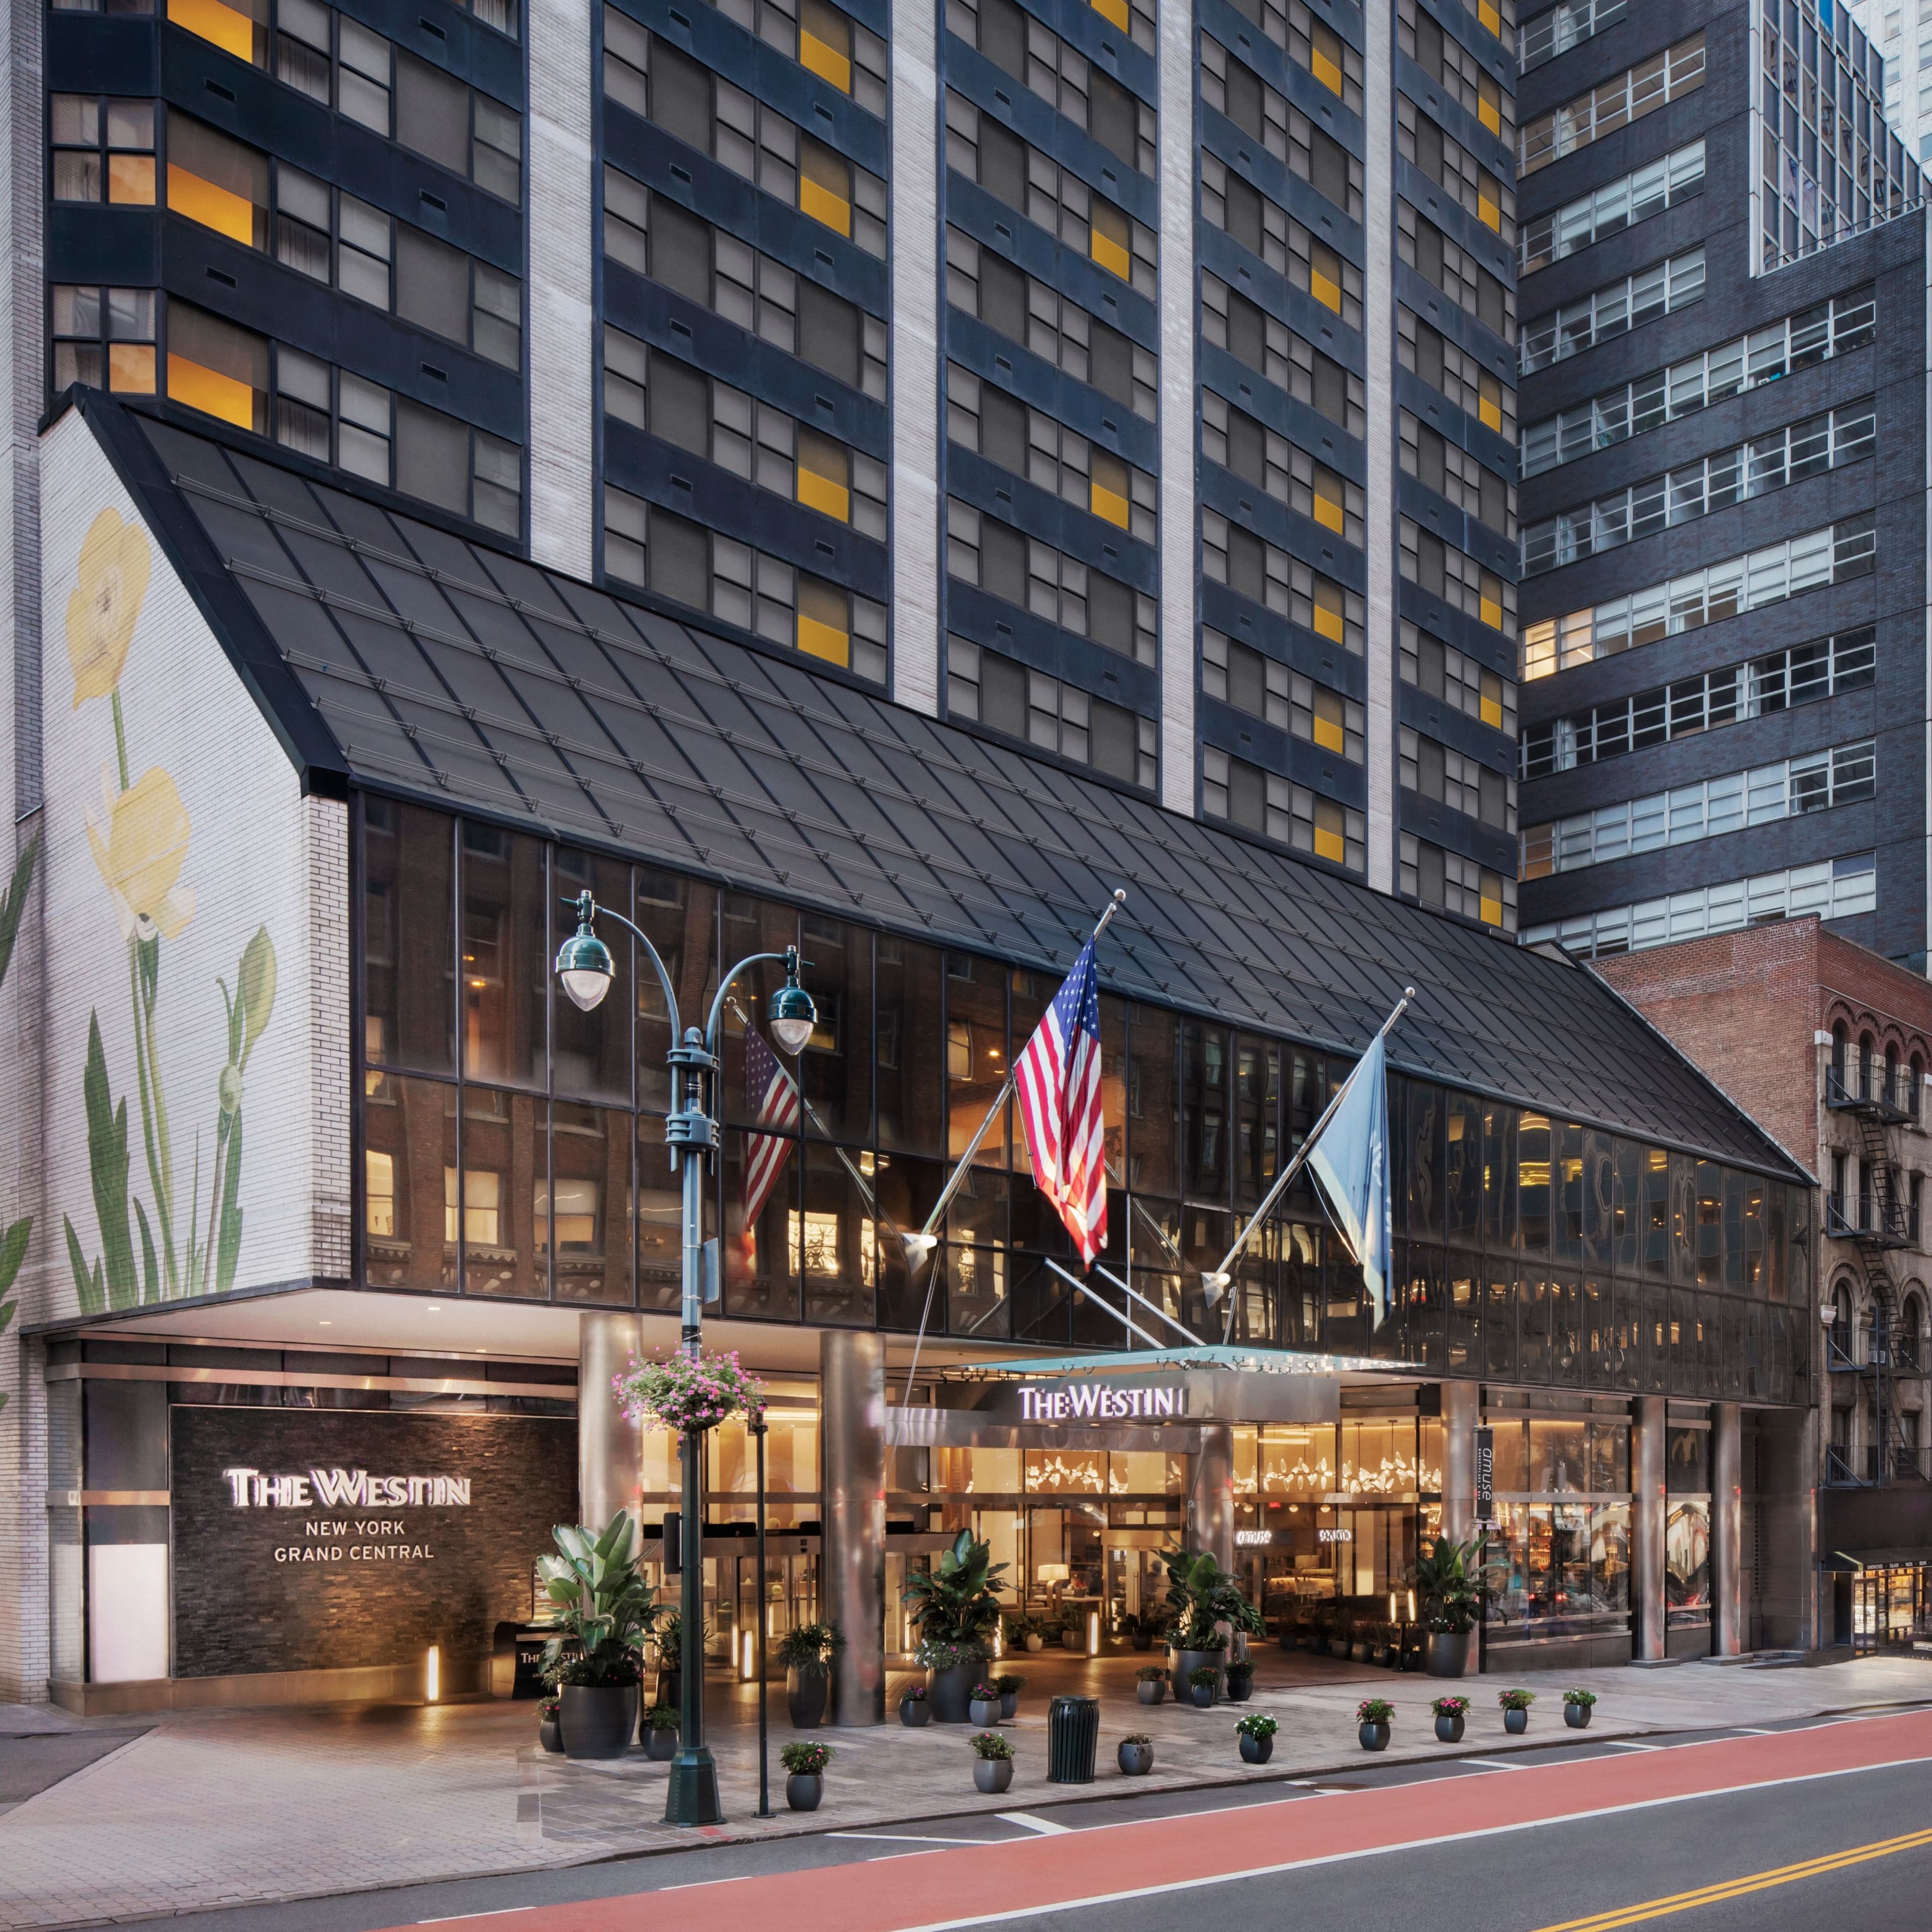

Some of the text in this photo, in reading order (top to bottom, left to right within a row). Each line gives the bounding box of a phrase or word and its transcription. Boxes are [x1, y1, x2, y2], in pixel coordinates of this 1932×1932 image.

[1018, 1384, 1173, 1419] THE WESTIN
[224, 1468, 471, 1507] THE WESTIN
[1482, 1448, 1492, 1500] amuse
[306, 1521, 405, 1536] NEW YORK
[274, 1544, 435, 1562] GRAND CENTRAL
